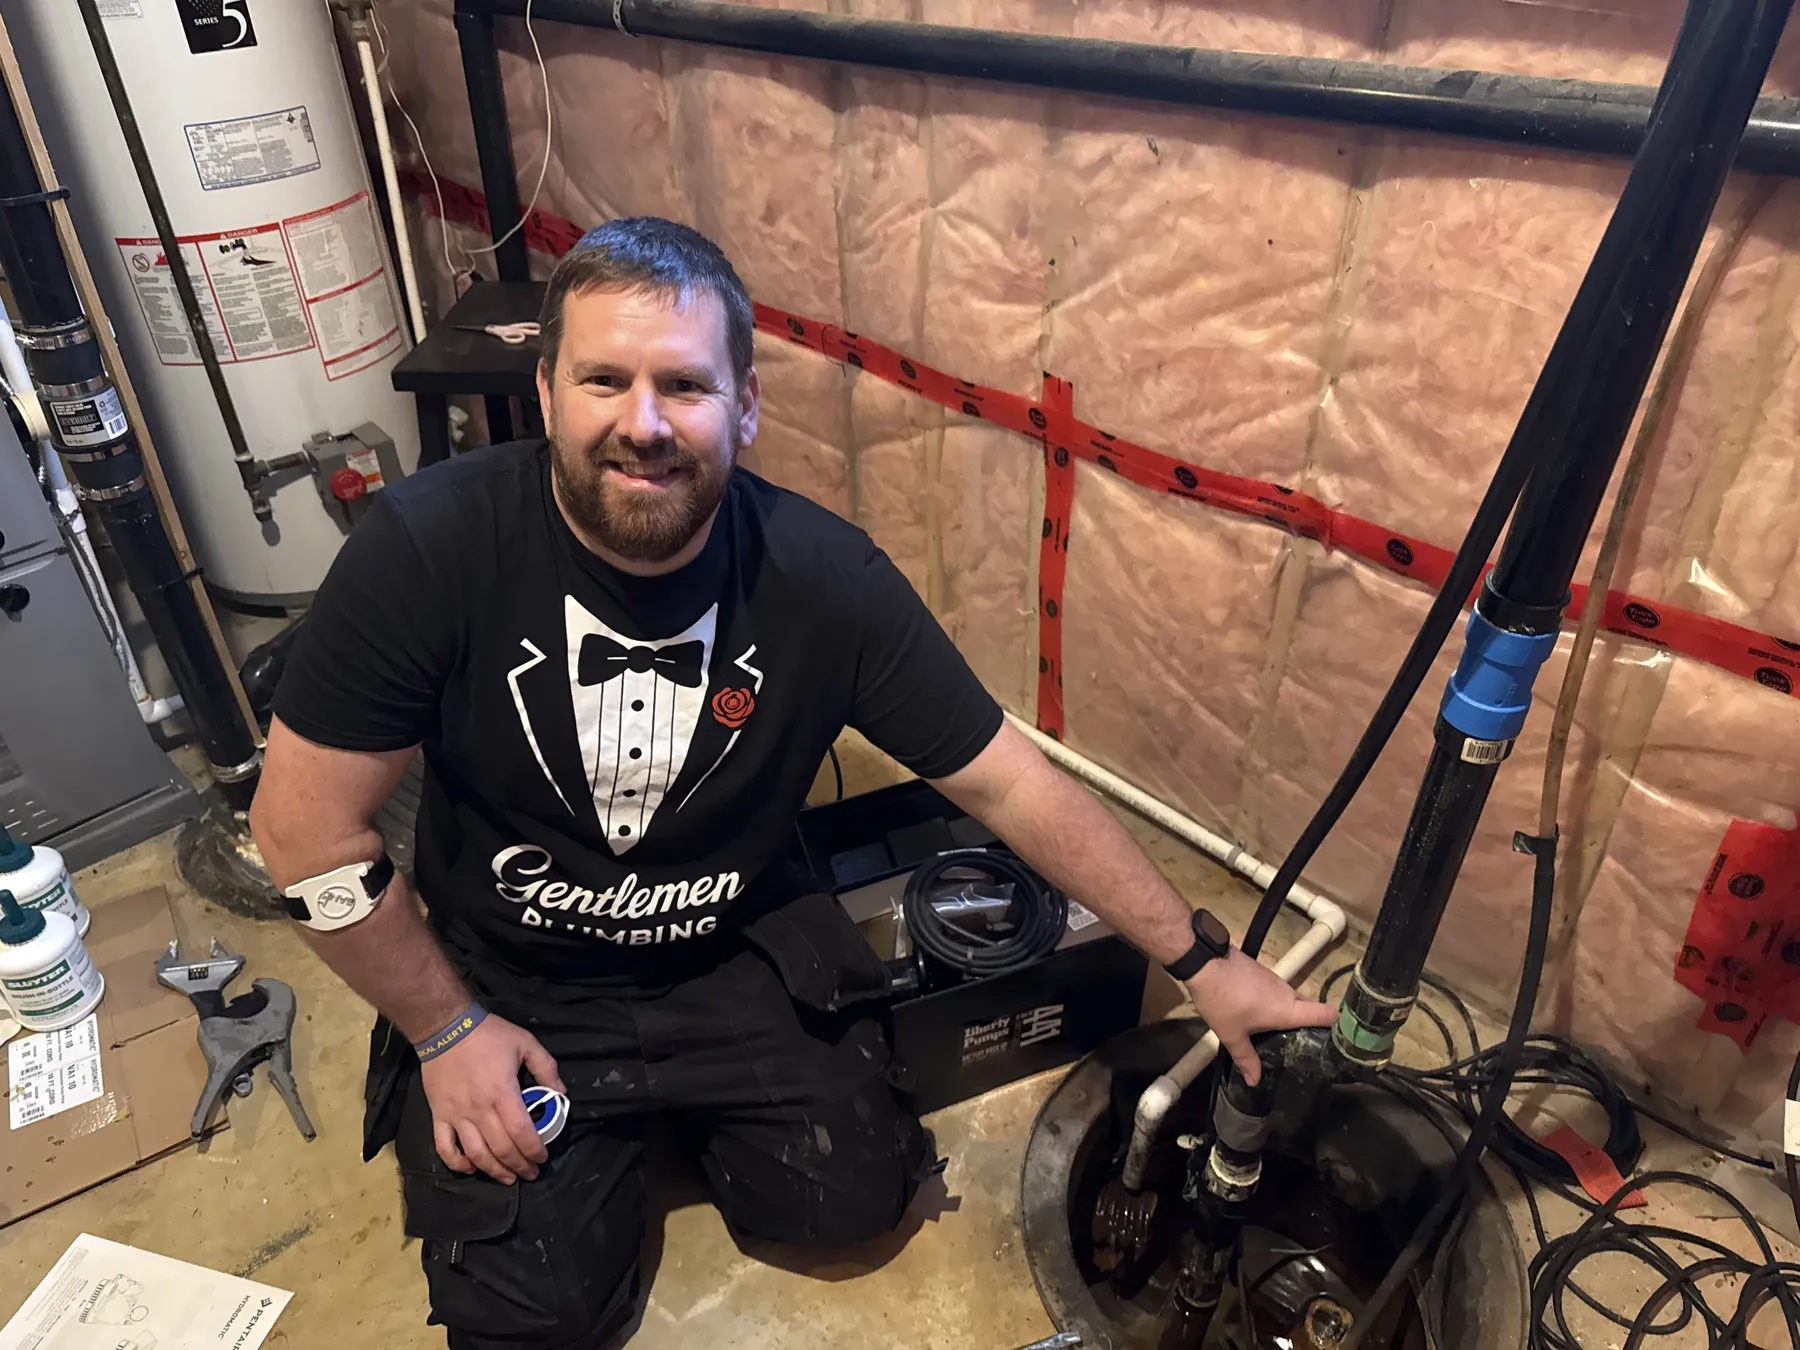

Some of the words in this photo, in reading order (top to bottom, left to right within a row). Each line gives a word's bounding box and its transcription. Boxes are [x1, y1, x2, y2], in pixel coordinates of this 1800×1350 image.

[193, 16, 219, 27] SERIES
[221, 0, 248, 48] 5
[227, 228, 259, 238] DANGER
[491, 844, 745, 919] Gentlemen
[521, 906, 718, 945] PMBING
[437, 1025, 464, 1049] ALERT
[965, 1015, 1010, 1037] Liberty
[963, 1028, 1010, 1048] Pumps
[46, 1047, 54, 1063] CORD
[67, 1064, 76, 1080] VA1
[90, 1058, 101, 1093] HYDROMATIC
[48, 1088, 56, 1105] CORD
[68, 1082, 77, 1090] 10
[217, 1294, 251, 1341] HYDROMATIC
[232, 1309, 264, 1350] PENTAIR
